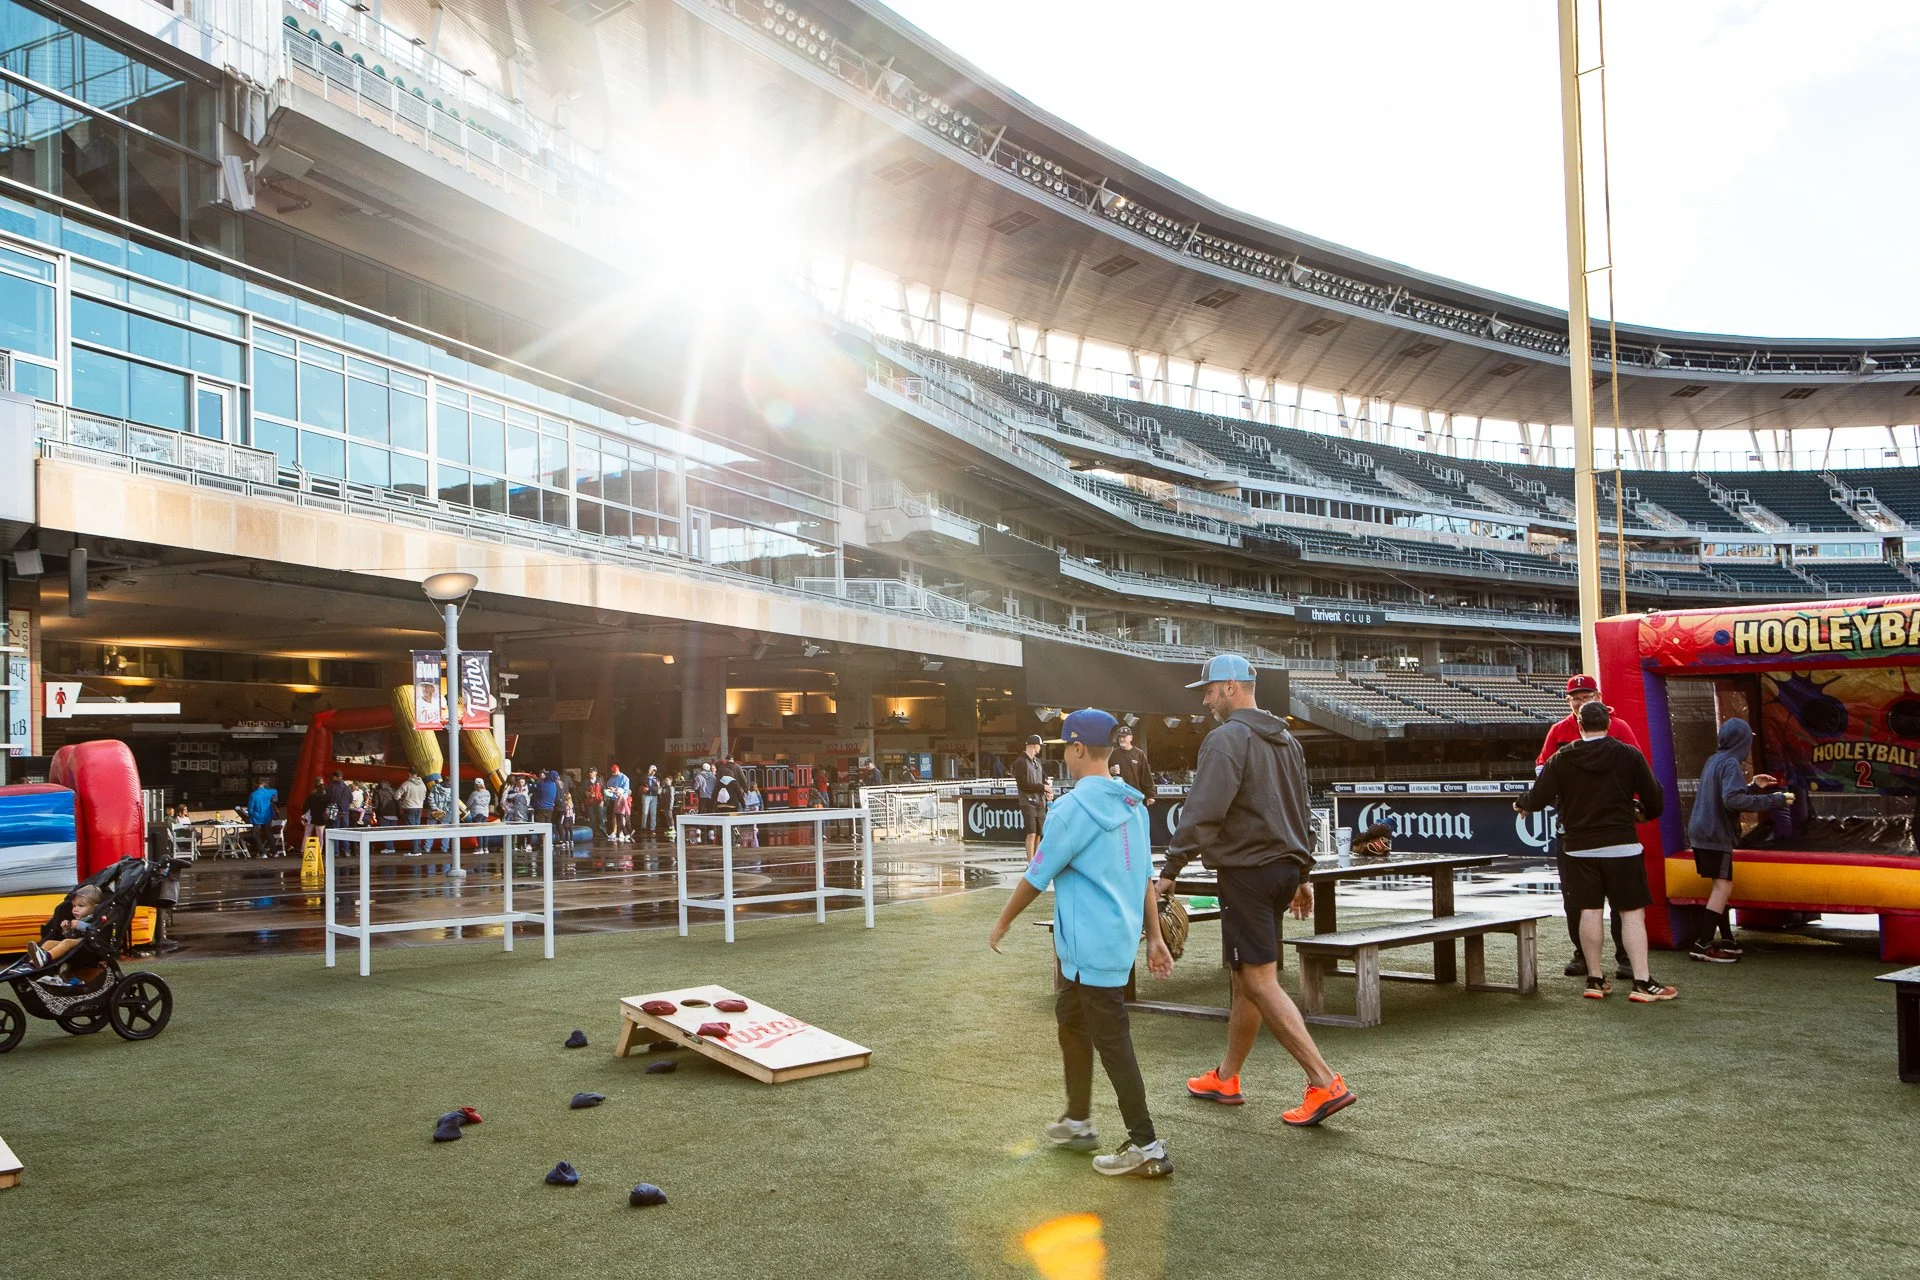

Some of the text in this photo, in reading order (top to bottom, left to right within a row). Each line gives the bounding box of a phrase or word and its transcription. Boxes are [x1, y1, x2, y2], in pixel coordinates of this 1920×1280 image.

[1311, 609, 1371, 624] thrivent CLUB
[10, 662, 27, 681] GUE
[463, 658, 490, 718] Twins
[237, 720, 284, 728] AUTHENTICS
[1813, 742, 1918, 769] HOOLEYBALL
[1855, 760, 1873, 788] 2
[1334, 784, 1352, 792] Corona
[1388, 784, 1406, 792] Corona
[1443, 784, 1463, 792] Corona
[1504, 783, 1525, 791] Corona
[968, 802, 1025, 837] Coron
[1358, 802, 1473, 850] Corona
